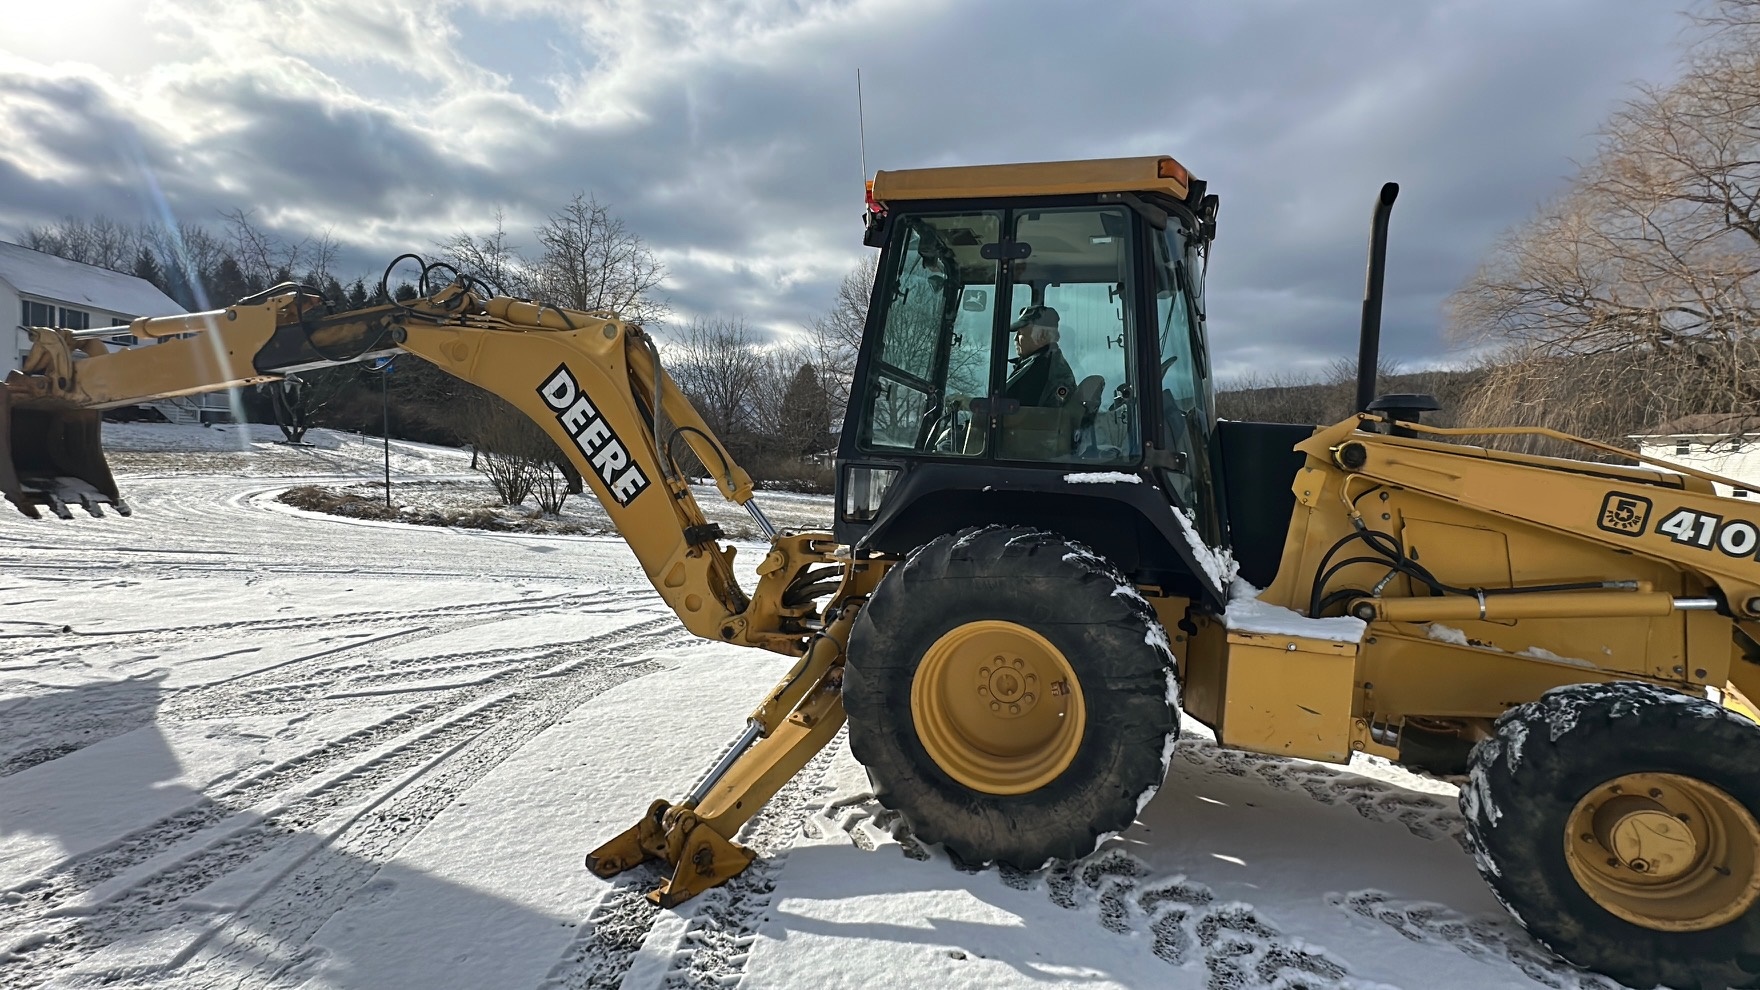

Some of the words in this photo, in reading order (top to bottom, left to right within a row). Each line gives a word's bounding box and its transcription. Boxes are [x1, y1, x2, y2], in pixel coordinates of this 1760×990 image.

[541, 368, 646, 503] DEERE
[1605, 510, 1620, 528] FIVE
[1621, 515, 1642, 529] STAR
[1616, 499, 1637, 522] 5
[1660, 510, 1757, 555] 410
